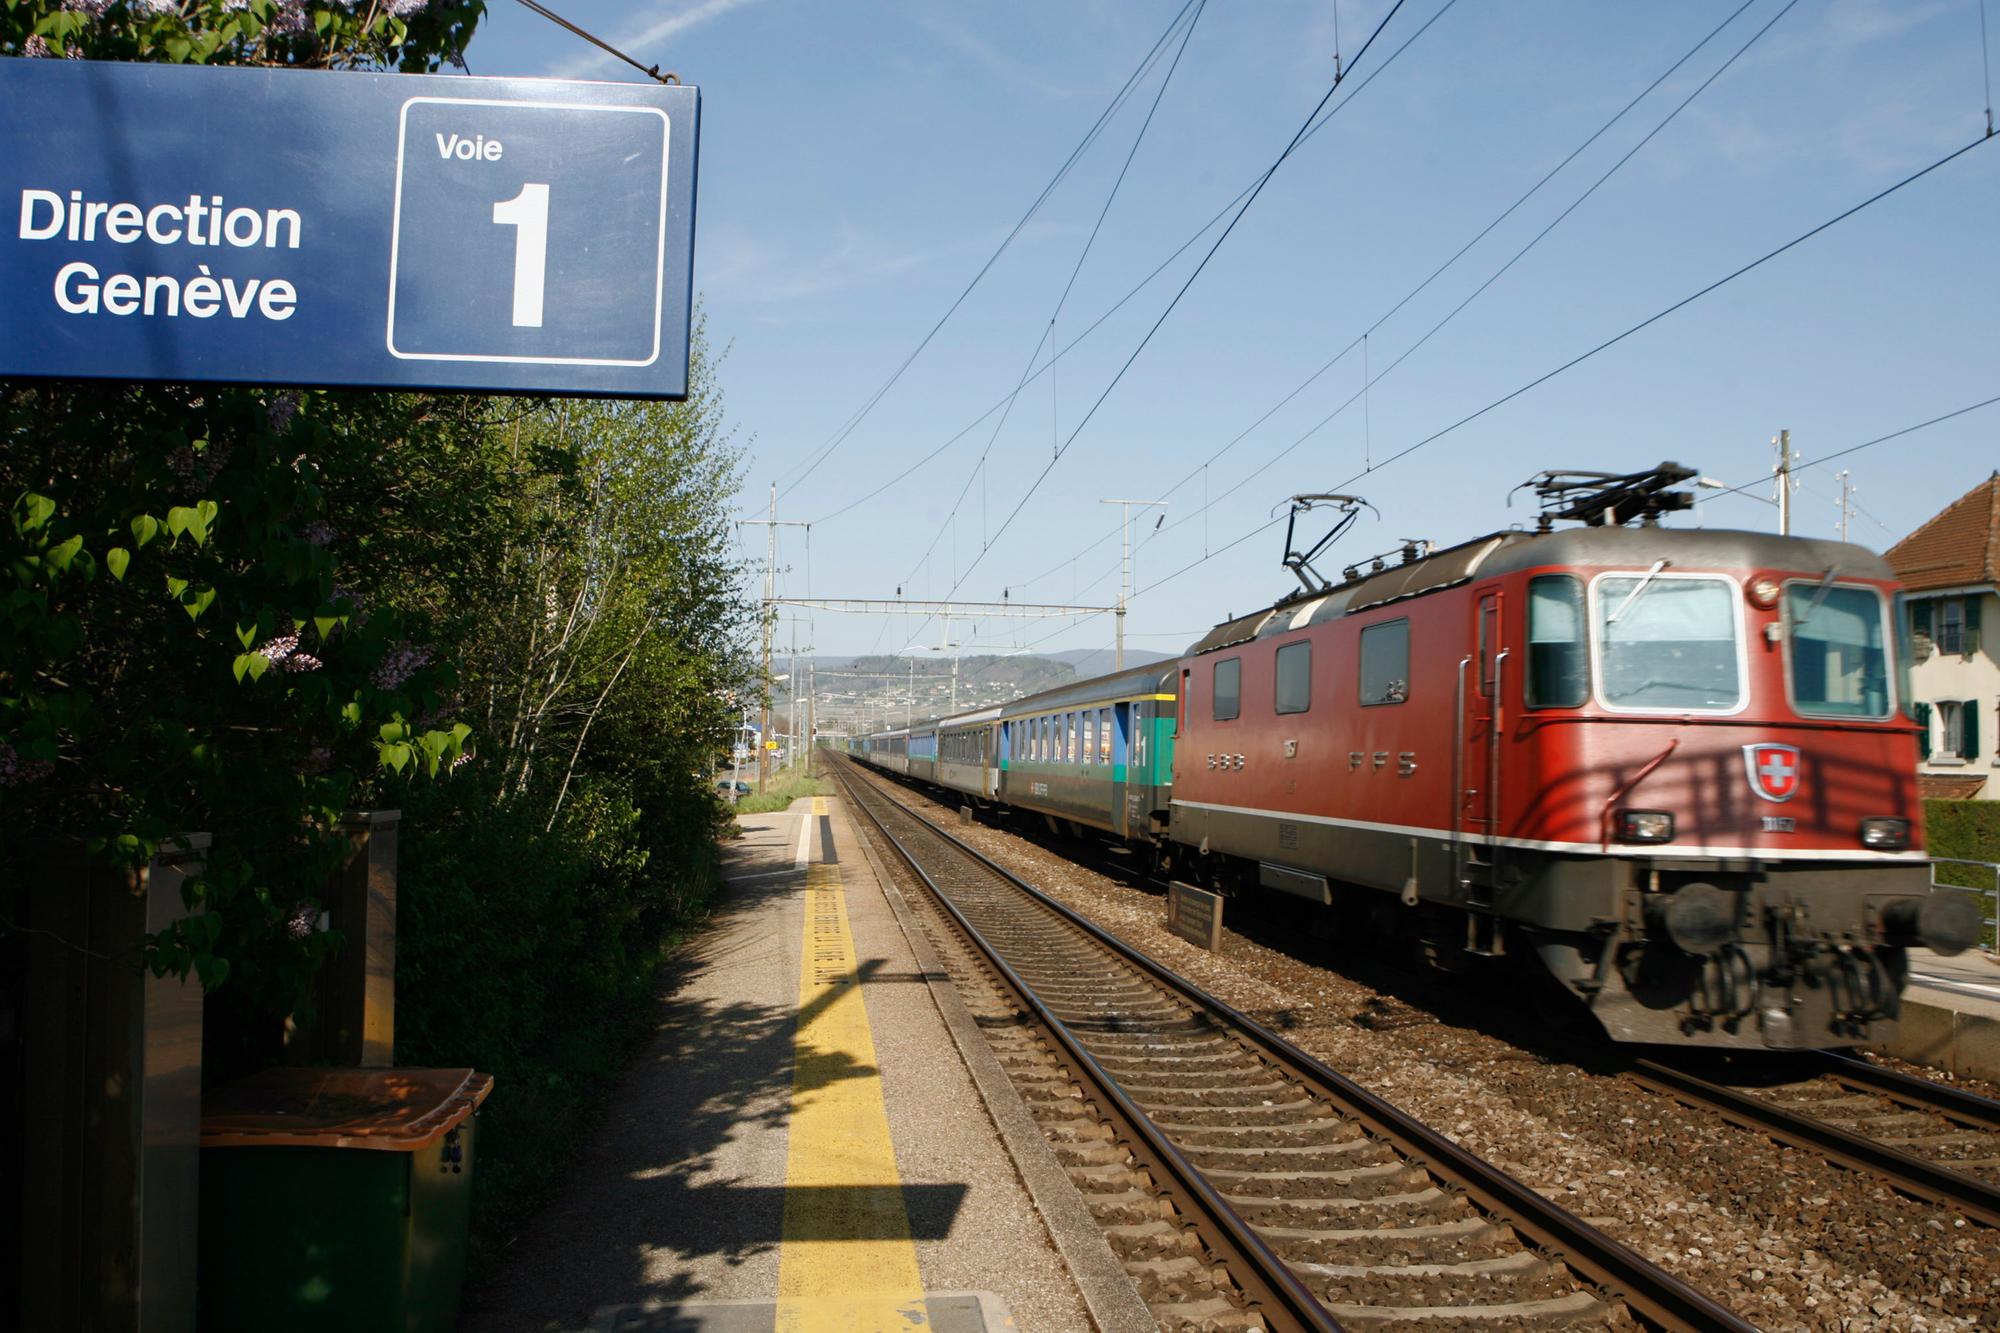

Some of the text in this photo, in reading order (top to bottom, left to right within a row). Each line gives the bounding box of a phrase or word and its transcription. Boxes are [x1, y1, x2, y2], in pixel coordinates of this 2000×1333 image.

[436, 133, 503, 161] Voie
[20, 188, 301, 248] Direction
[493, 183, 549, 327] 1
[55, 262, 296, 320] Genève
[1349, 751, 1416, 775] FFS
